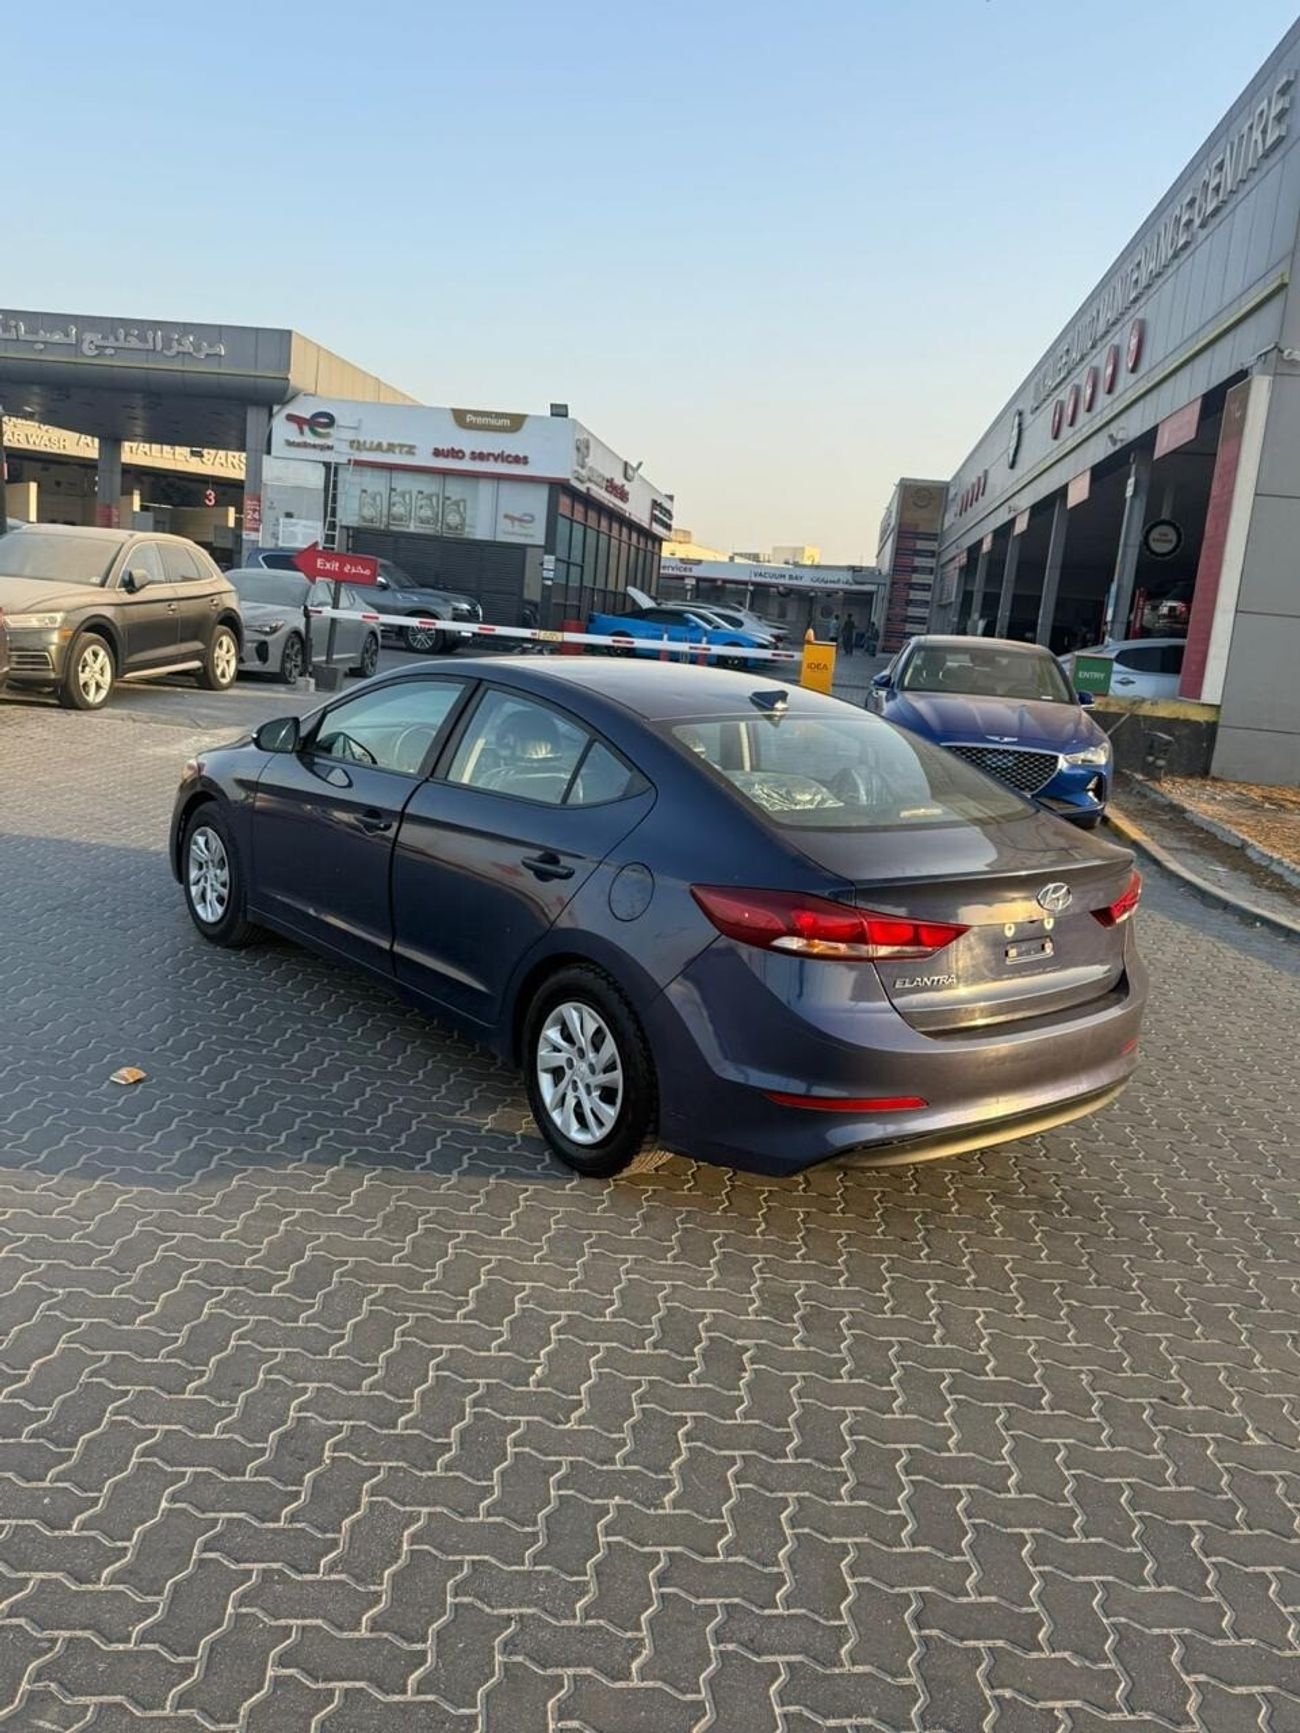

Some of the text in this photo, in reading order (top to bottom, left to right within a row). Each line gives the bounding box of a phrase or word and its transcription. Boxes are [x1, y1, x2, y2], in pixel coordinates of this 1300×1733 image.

[1098, 190, 1198, 337] MAINTENANCE
[1196, 71, 1296, 230] CENTRE
[0, 314, 225, 359] مركز الخليج لصيان
[465, 413, 512, 428] Premium
[25, 432, 67, 450] WASH
[349, 438, 417, 457] QUARTZ
[431, 445, 529, 466] auto services
[205, 489, 216, 506] 3
[316, 558, 339, 571] Exit
[343, 564, 372, 576] مخرج
[661, 563, 693, 573] ervices
[753, 570, 786, 581] VACUUM
[807, 662, 829, 671] IDEA
[1078, 671, 1106, 681] ENTRY
[895, 975, 956, 989] ELANTRA
